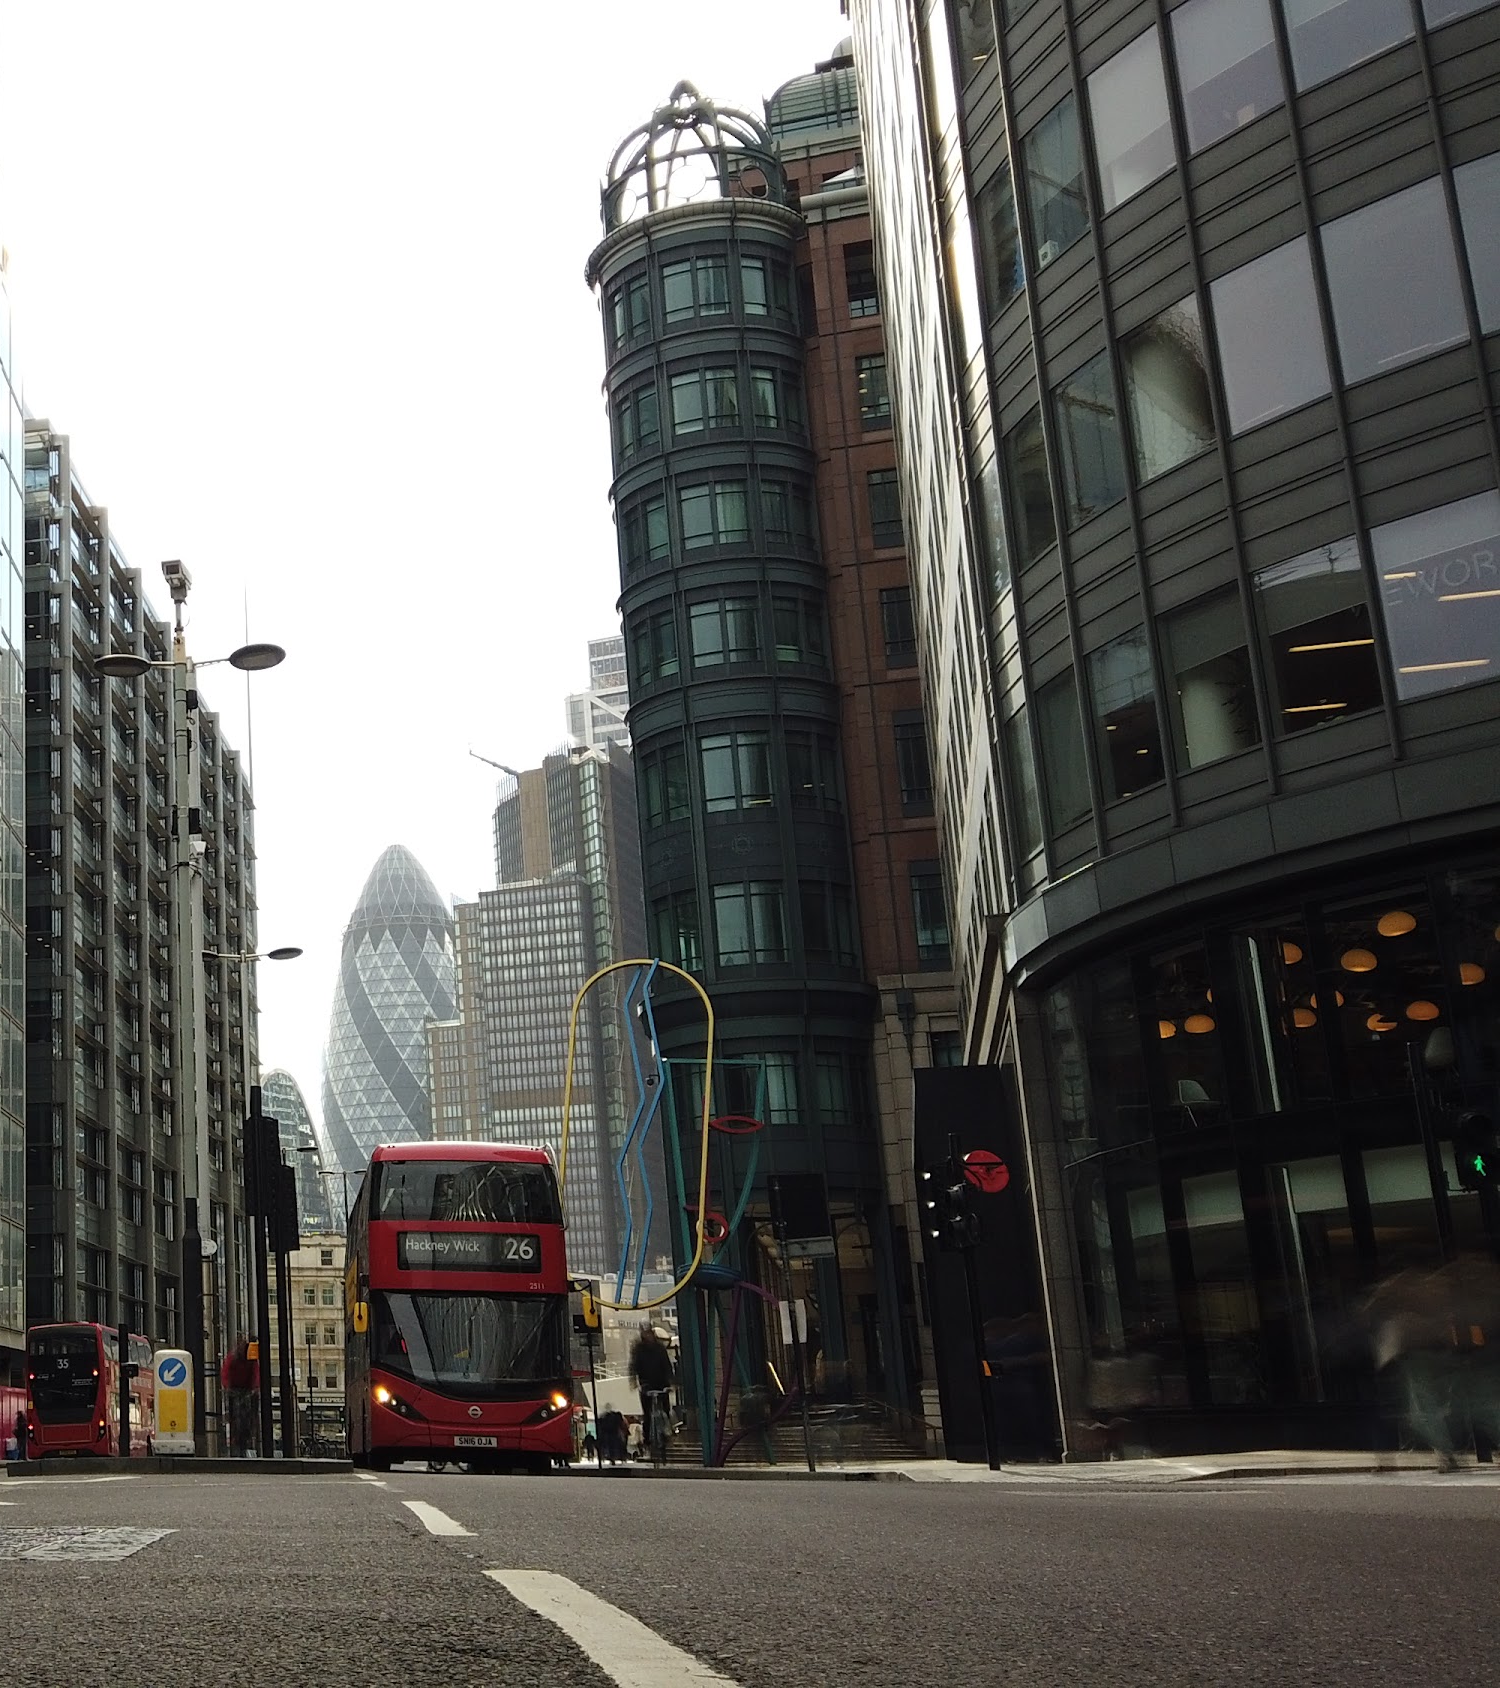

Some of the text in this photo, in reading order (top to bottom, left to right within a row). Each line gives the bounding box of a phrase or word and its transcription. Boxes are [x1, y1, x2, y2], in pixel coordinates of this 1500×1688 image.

[405, 1238, 480, 1254] Hackney Wick
[505, 1238, 534, 1260] 26
[529, 1282, 545, 1290] 2511
[57, 1359, 69, 1369] 35
[458, 1437, 493, 1446] SN16 OJA
